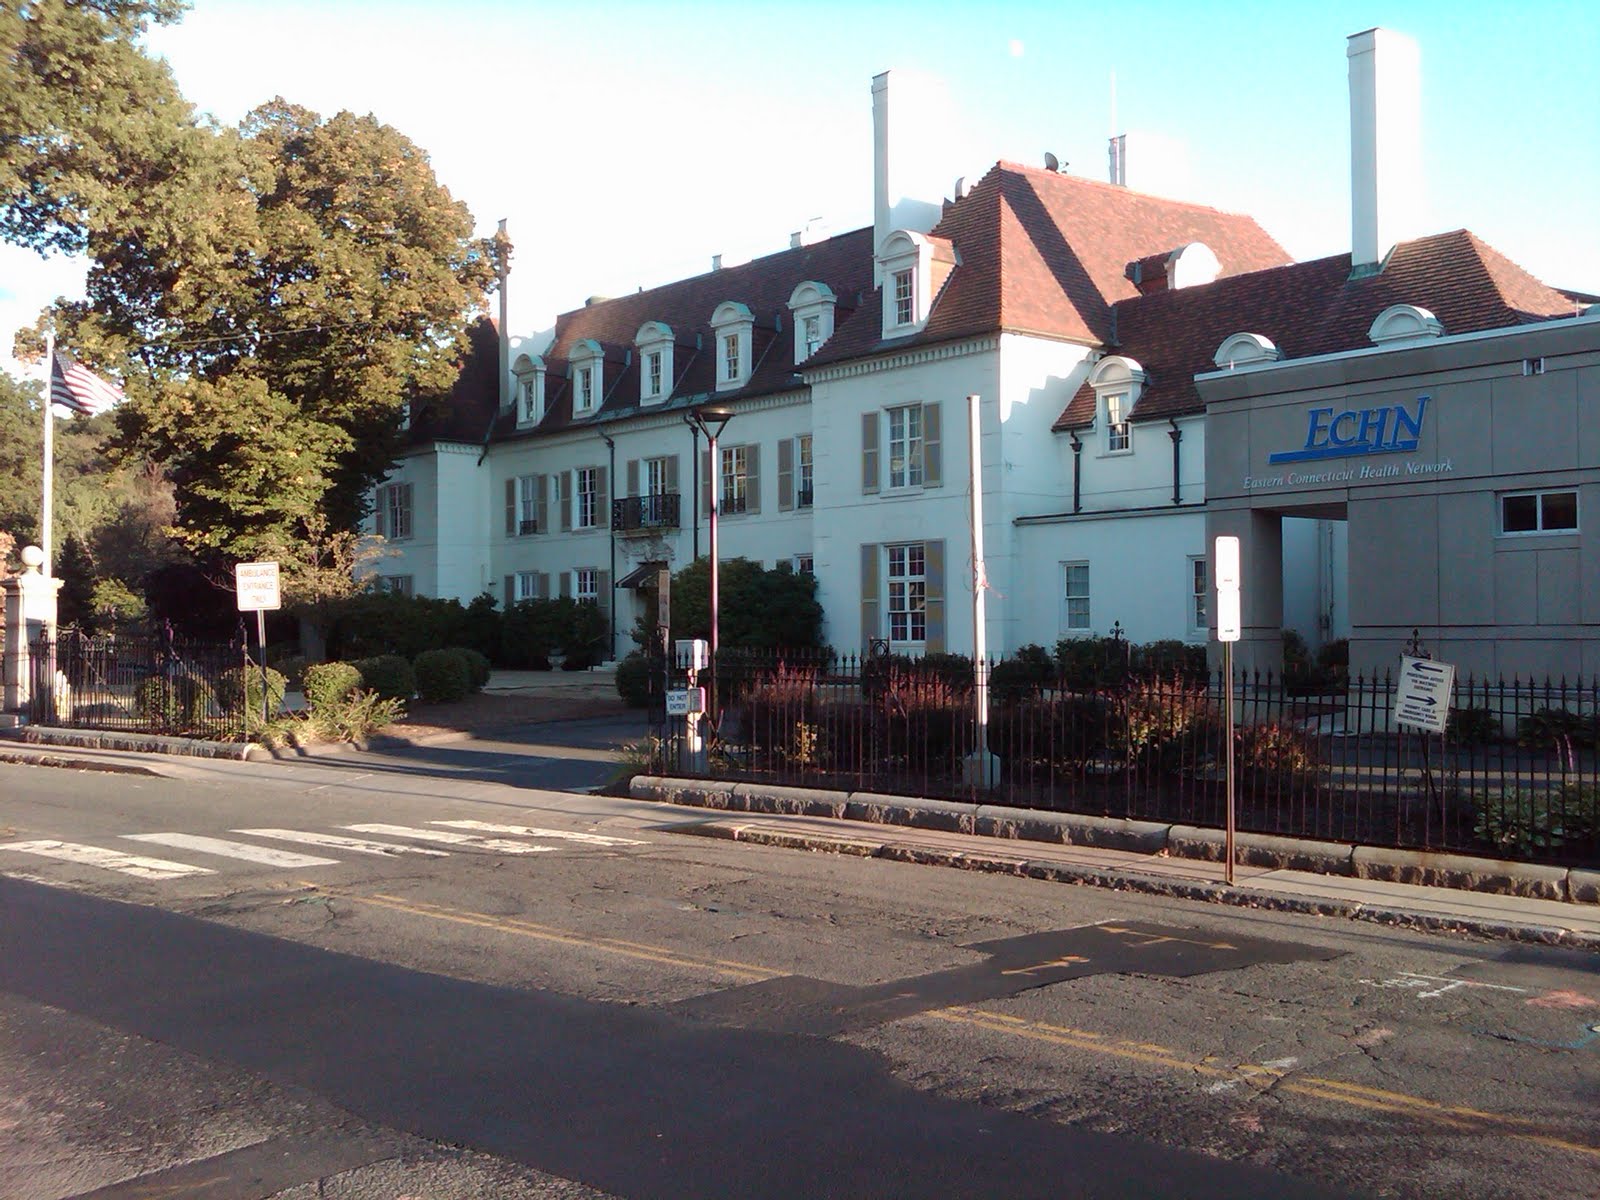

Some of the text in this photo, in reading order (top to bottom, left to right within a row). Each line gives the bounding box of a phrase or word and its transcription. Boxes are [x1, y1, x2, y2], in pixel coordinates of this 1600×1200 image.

[1304, 393, 1432, 451] ECHN
[1243, 459, 1453, 490] Eastern Connecticut Health Network
